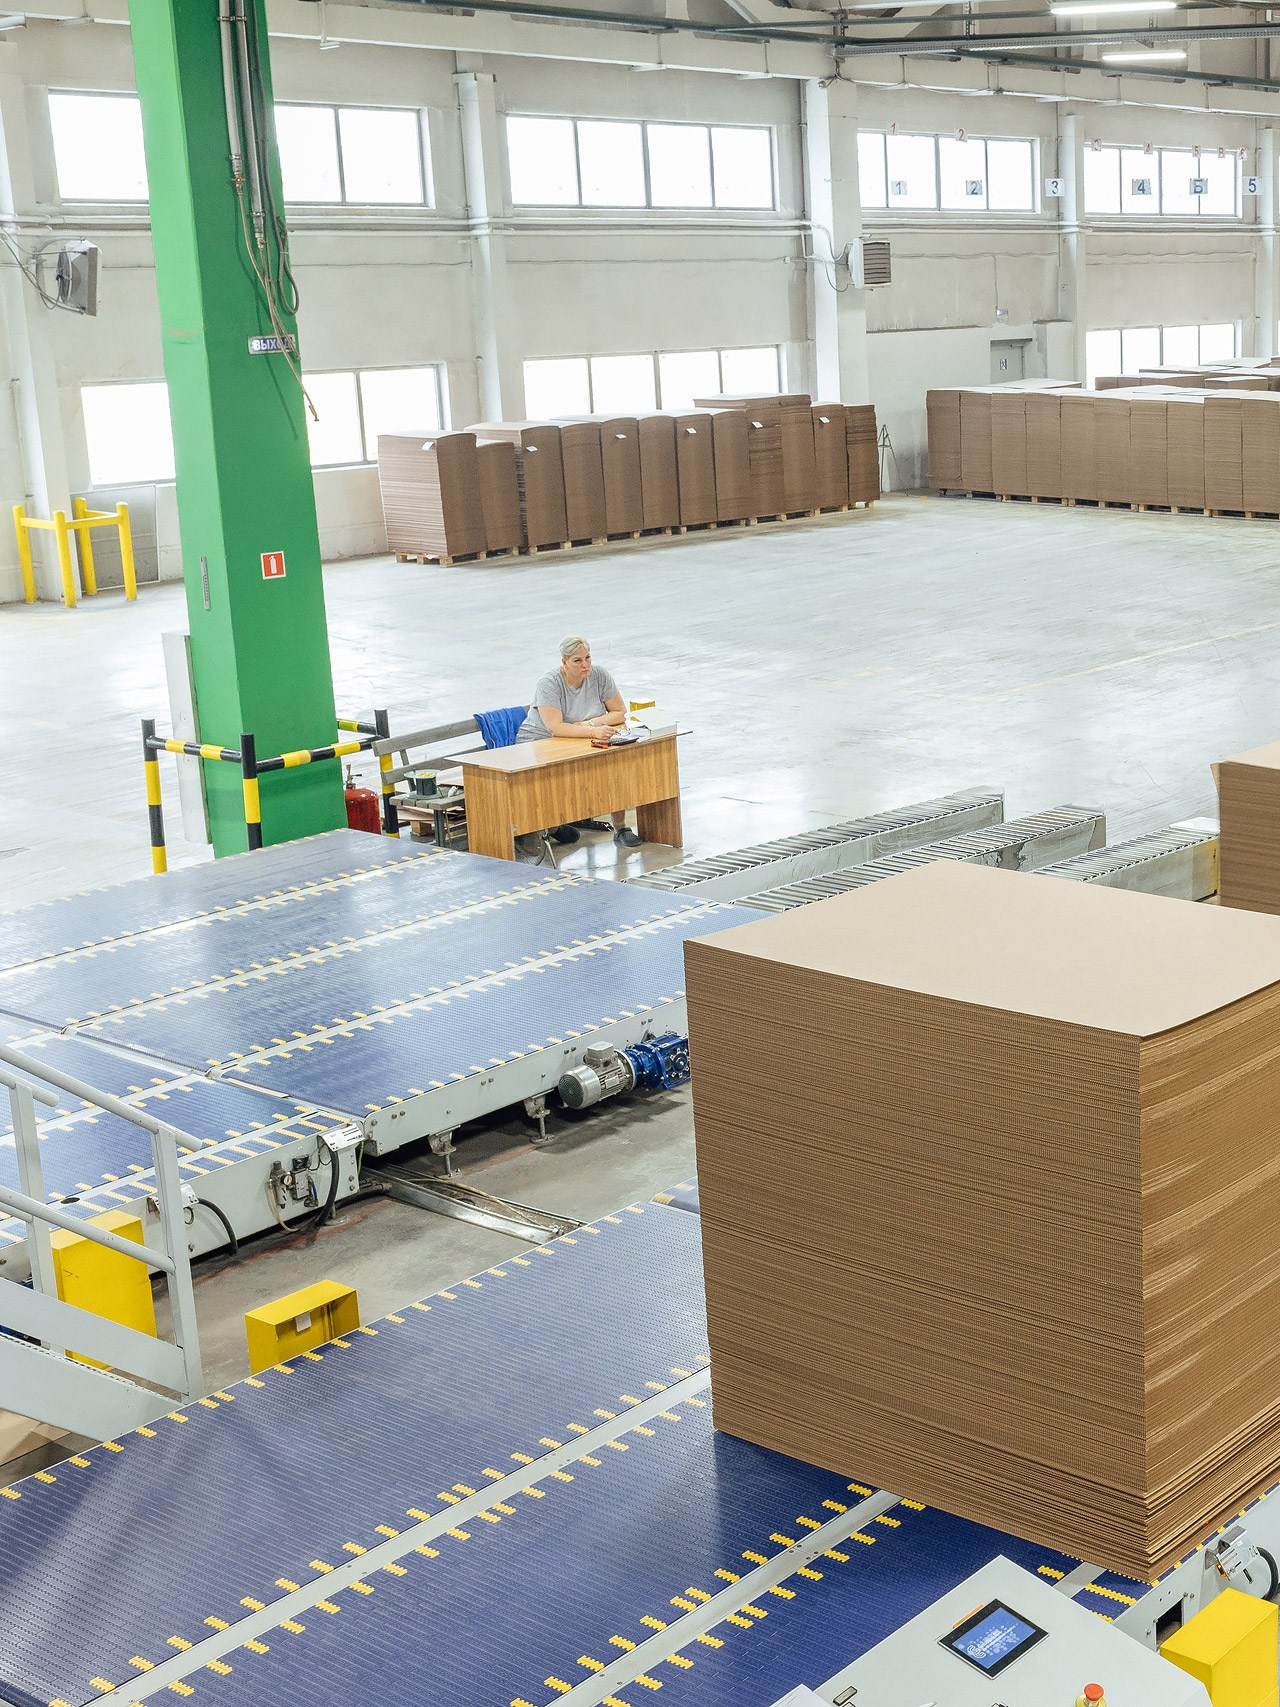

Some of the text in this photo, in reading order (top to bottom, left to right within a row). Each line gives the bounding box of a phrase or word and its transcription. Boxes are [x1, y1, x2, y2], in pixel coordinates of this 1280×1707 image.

[958, 128, 965, 141] 2
[895, 181, 902, 195] 1
[970, 181, 979, 195] 2
[1051, 180, 1059, 194] 3
[1137, 180, 1146, 194] 4
[1248, 178, 1257, 193] 5
